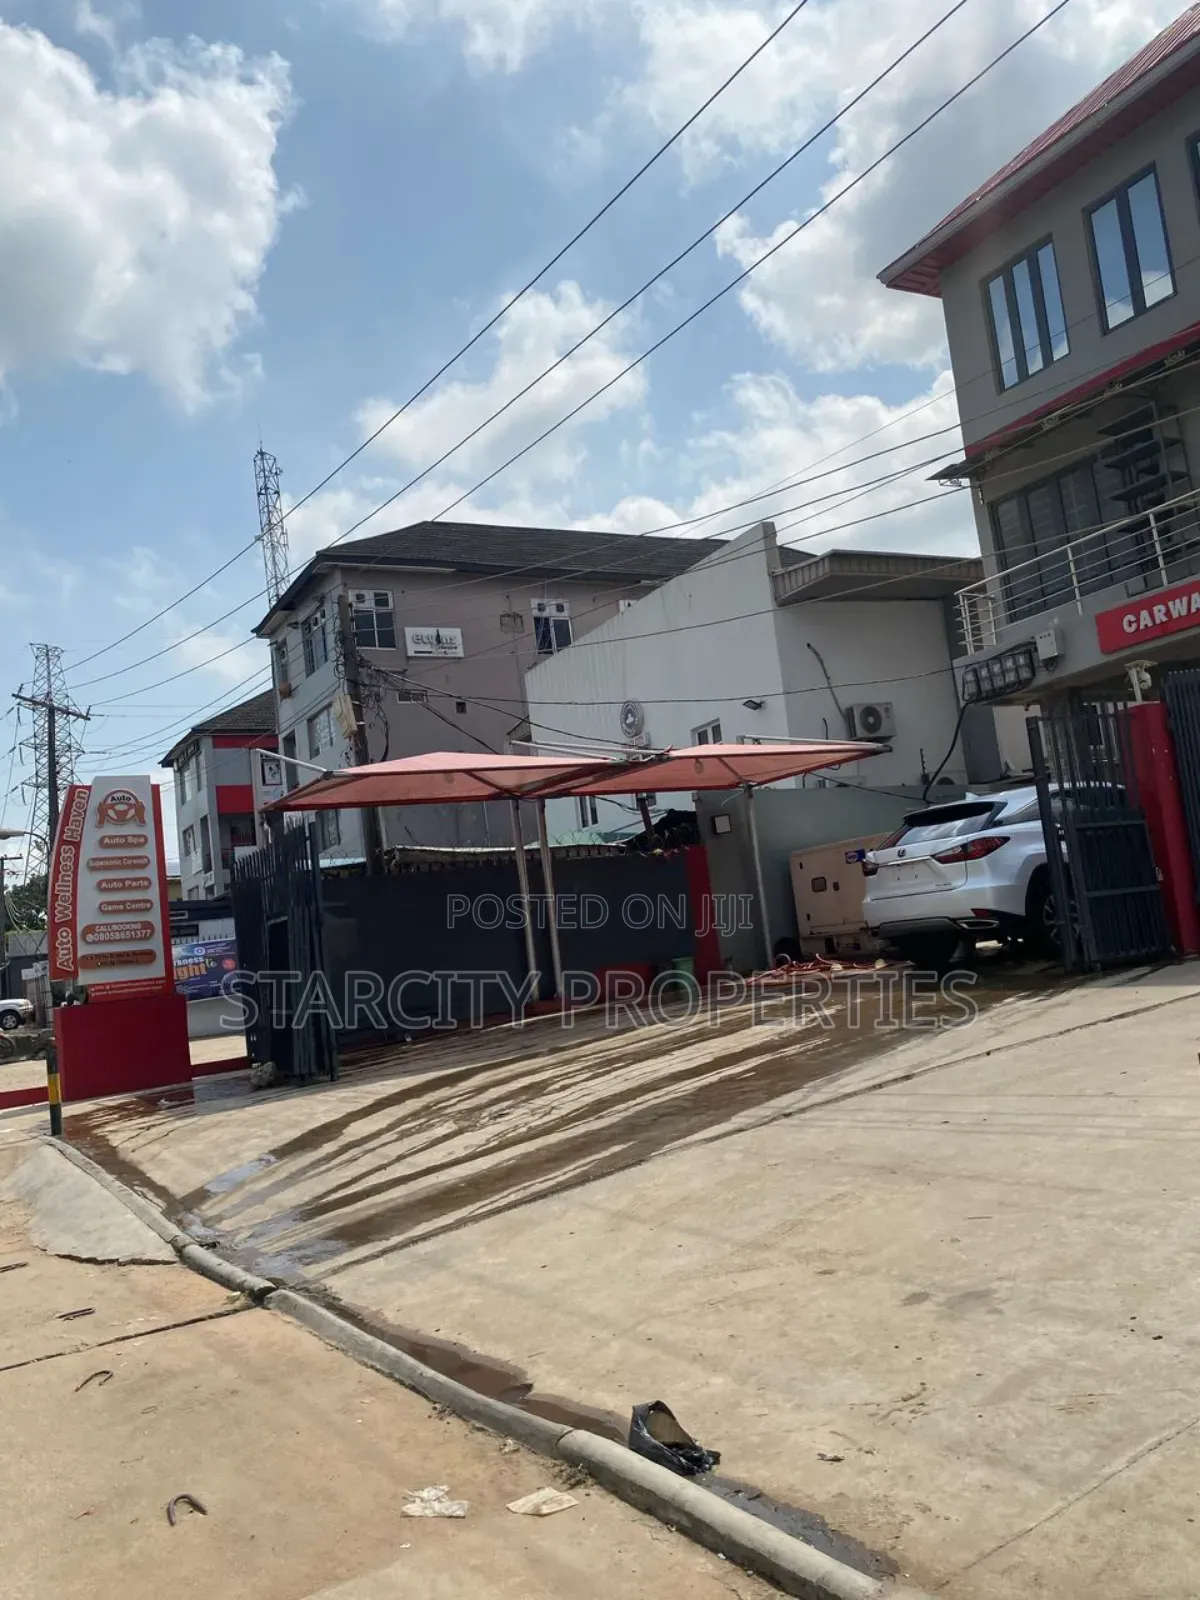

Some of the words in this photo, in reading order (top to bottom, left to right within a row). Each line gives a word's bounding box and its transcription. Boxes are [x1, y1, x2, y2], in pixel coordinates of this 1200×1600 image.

[110, 794, 132, 803] Auto
[64, 788, 90, 841] Haven
[103, 836, 126, 845] Auto
[128, 836, 145, 845] Spa
[55, 845, 75, 923] Wellness
[100, 880, 124, 889] Auto
[124, 878, 149, 888] Parts
[100, 903, 125, 912] Game
[125, 901, 151, 910] Centre
[93, 930, 151, 941] 08058651377
[57, 926, 74, 972] Auto
